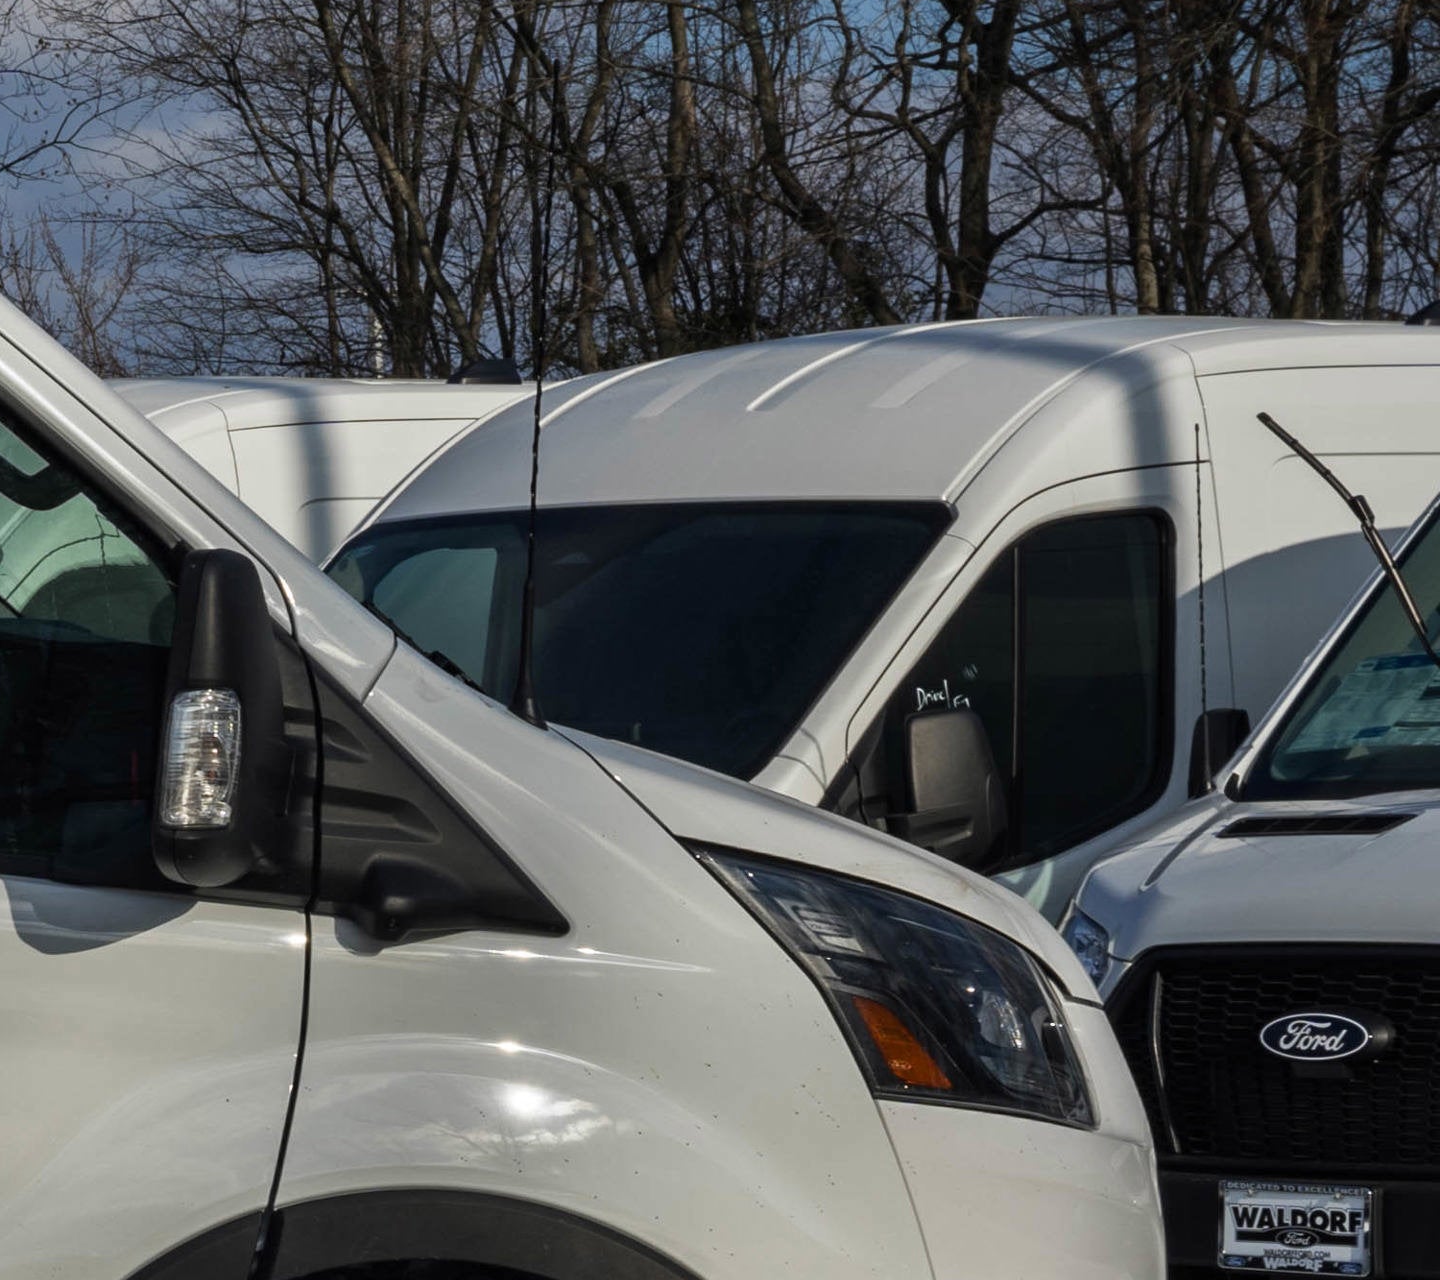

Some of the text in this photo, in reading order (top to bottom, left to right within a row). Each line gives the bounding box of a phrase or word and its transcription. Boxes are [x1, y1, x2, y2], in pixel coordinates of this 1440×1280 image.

[1279, 1020, 1348, 1051] Ford
[1227, 1181, 1280, 1191] DEDICATED
[1282, 1184, 1296, 1192] TO
[1231, 1206, 1362, 1233] WALDORF
[1283, 1231, 1311, 1246] Ford
[1263, 1257, 1323, 1272] WALDORF
